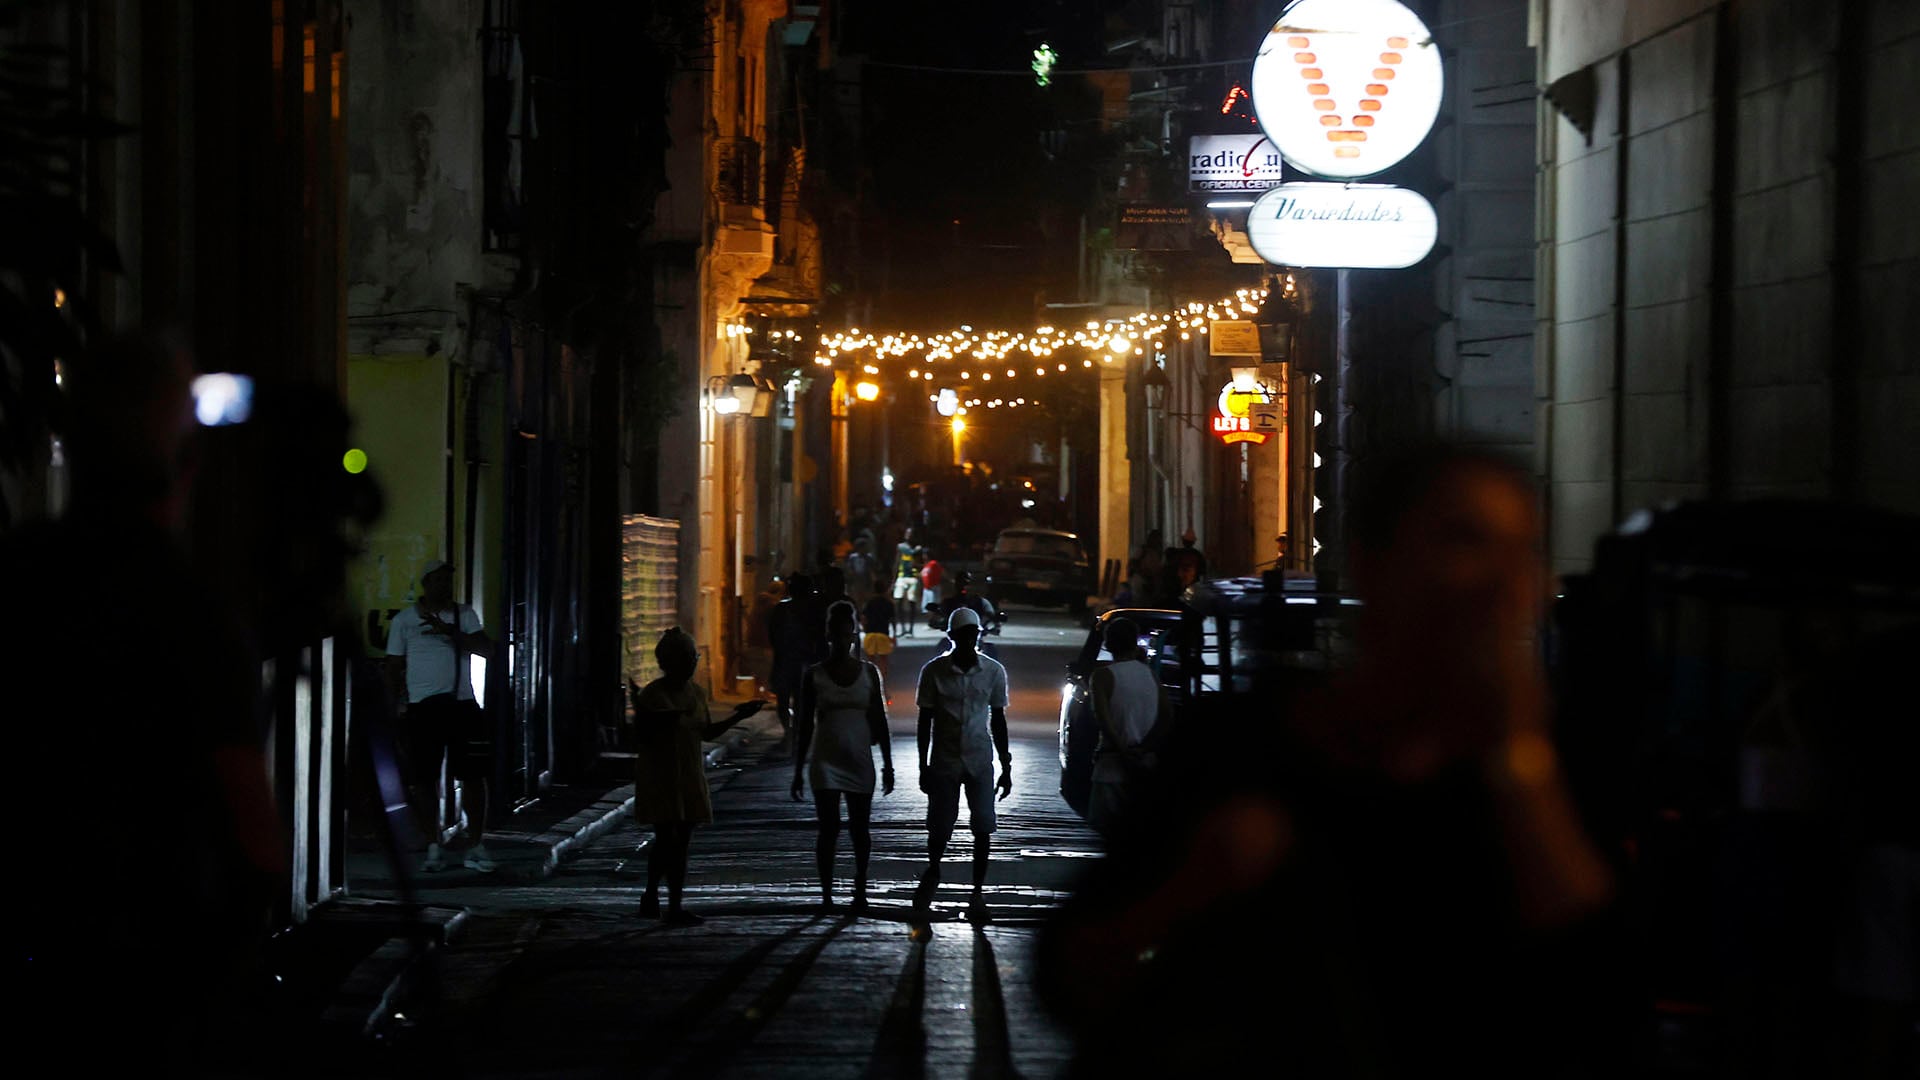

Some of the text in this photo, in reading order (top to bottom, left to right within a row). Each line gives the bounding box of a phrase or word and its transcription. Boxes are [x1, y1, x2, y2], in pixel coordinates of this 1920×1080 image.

[1287, 36, 1409, 159] V
[1199, 180, 1246, 190] OFICINA
[1274, 196, 1405, 222] Variedades
